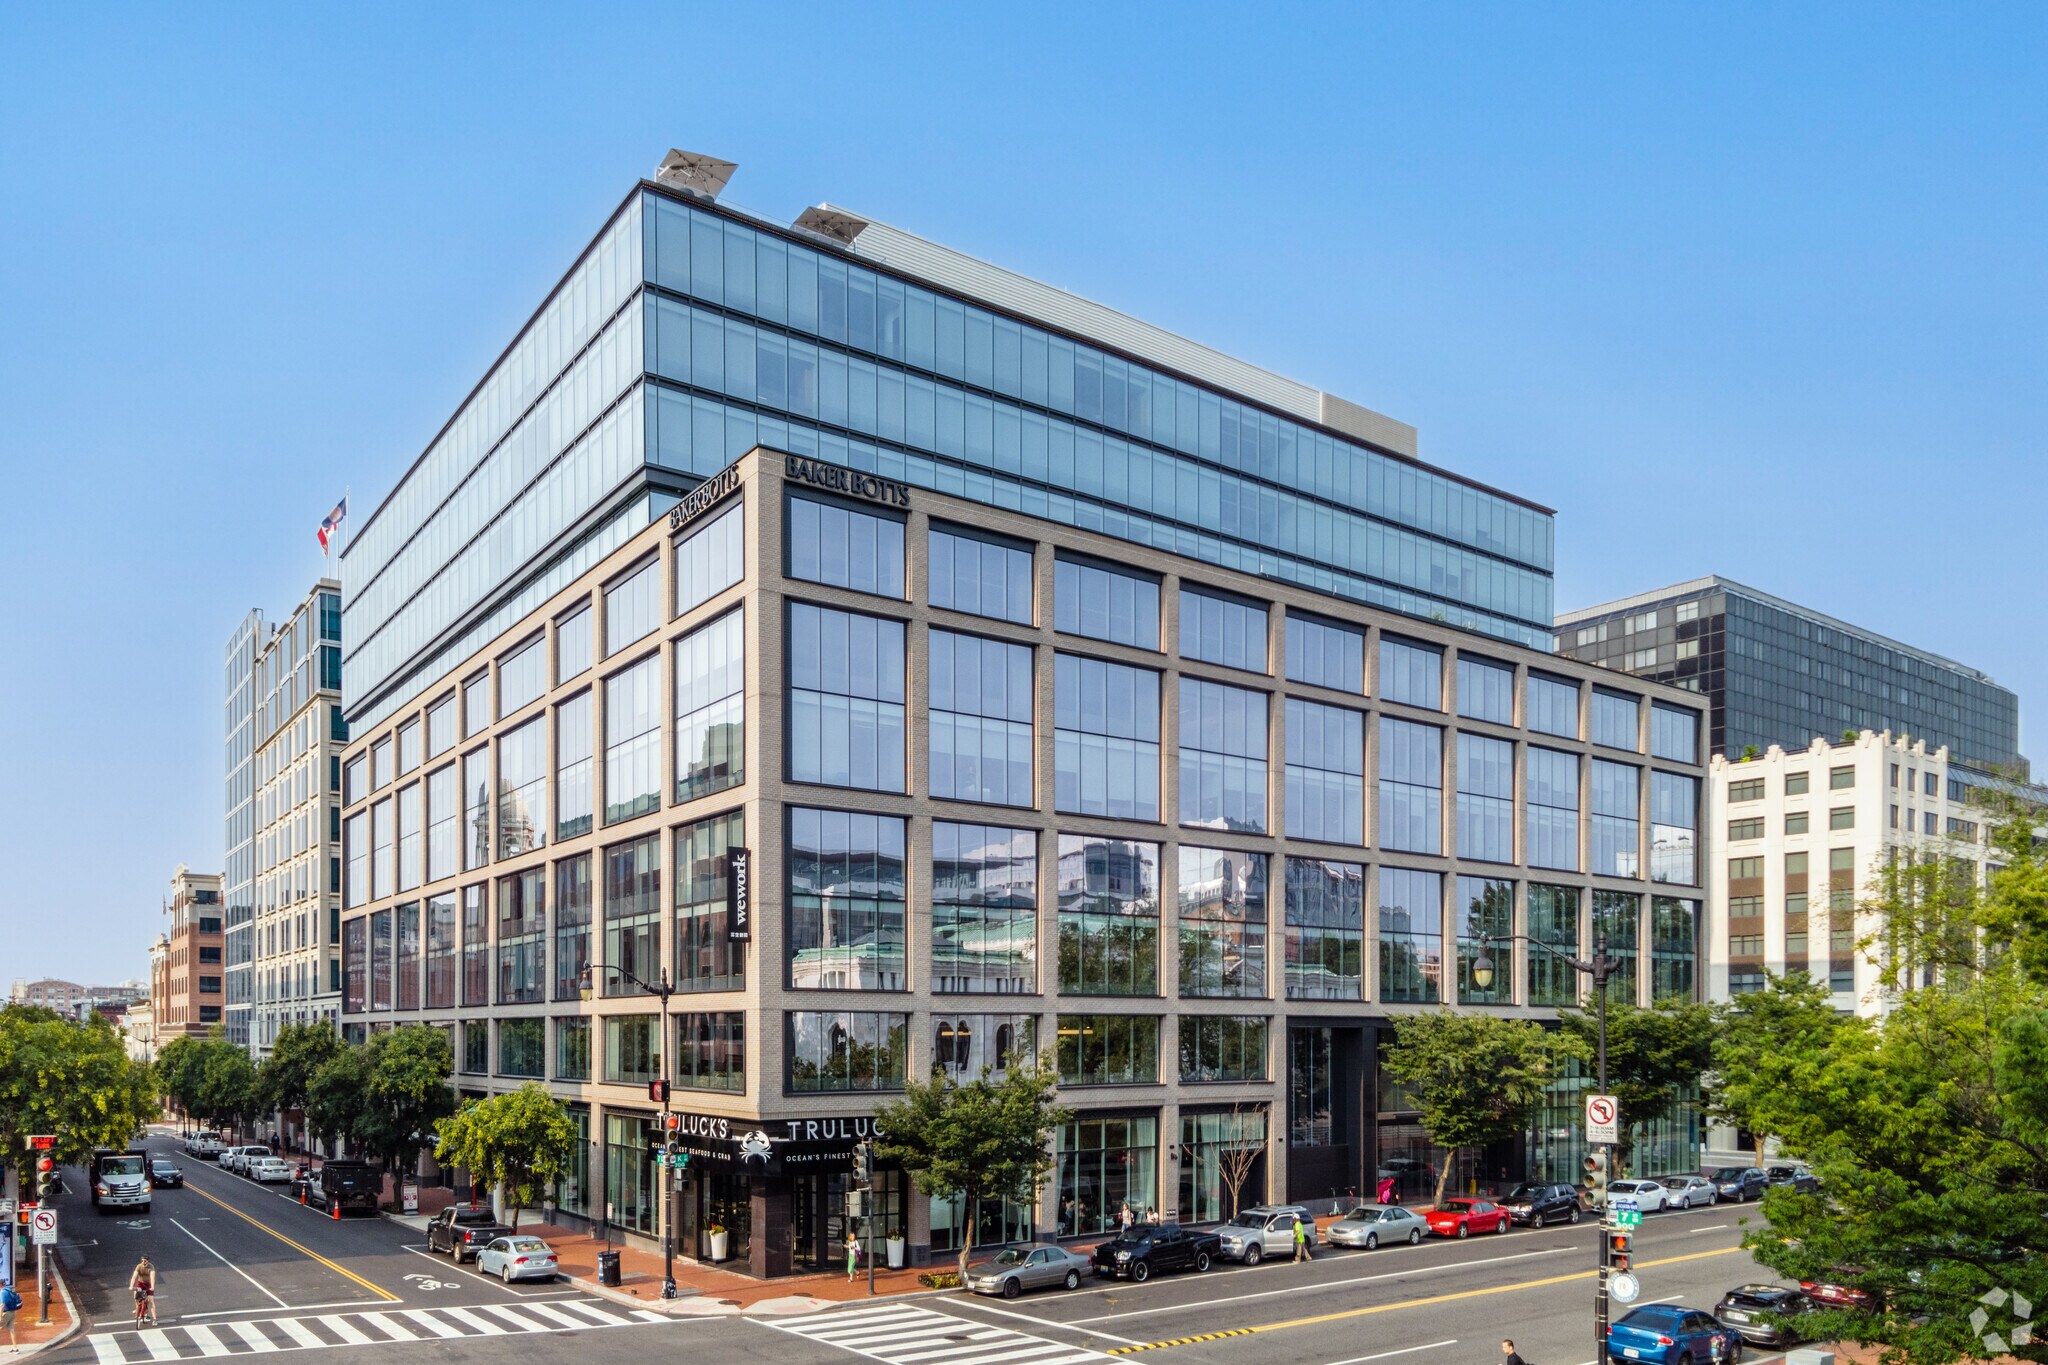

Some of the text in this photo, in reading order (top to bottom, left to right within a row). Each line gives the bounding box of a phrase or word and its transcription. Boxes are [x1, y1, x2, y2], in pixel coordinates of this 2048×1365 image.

[785, 455, 911, 506] BAKER BOTTS
[668, 463, 740, 529] BAKER BOTTS
[732, 853, 746, 926] wework
[656, 1112, 728, 1138] TULUCK'S
[787, 1118, 886, 1140] TRULUC
[689, 1148, 710, 1157] SEAFOOD
[786, 1154, 820, 1162] OCEAN'S
[824, 1152, 851, 1160] FINEST
[1620, 1212, 1628, 1222] 7
